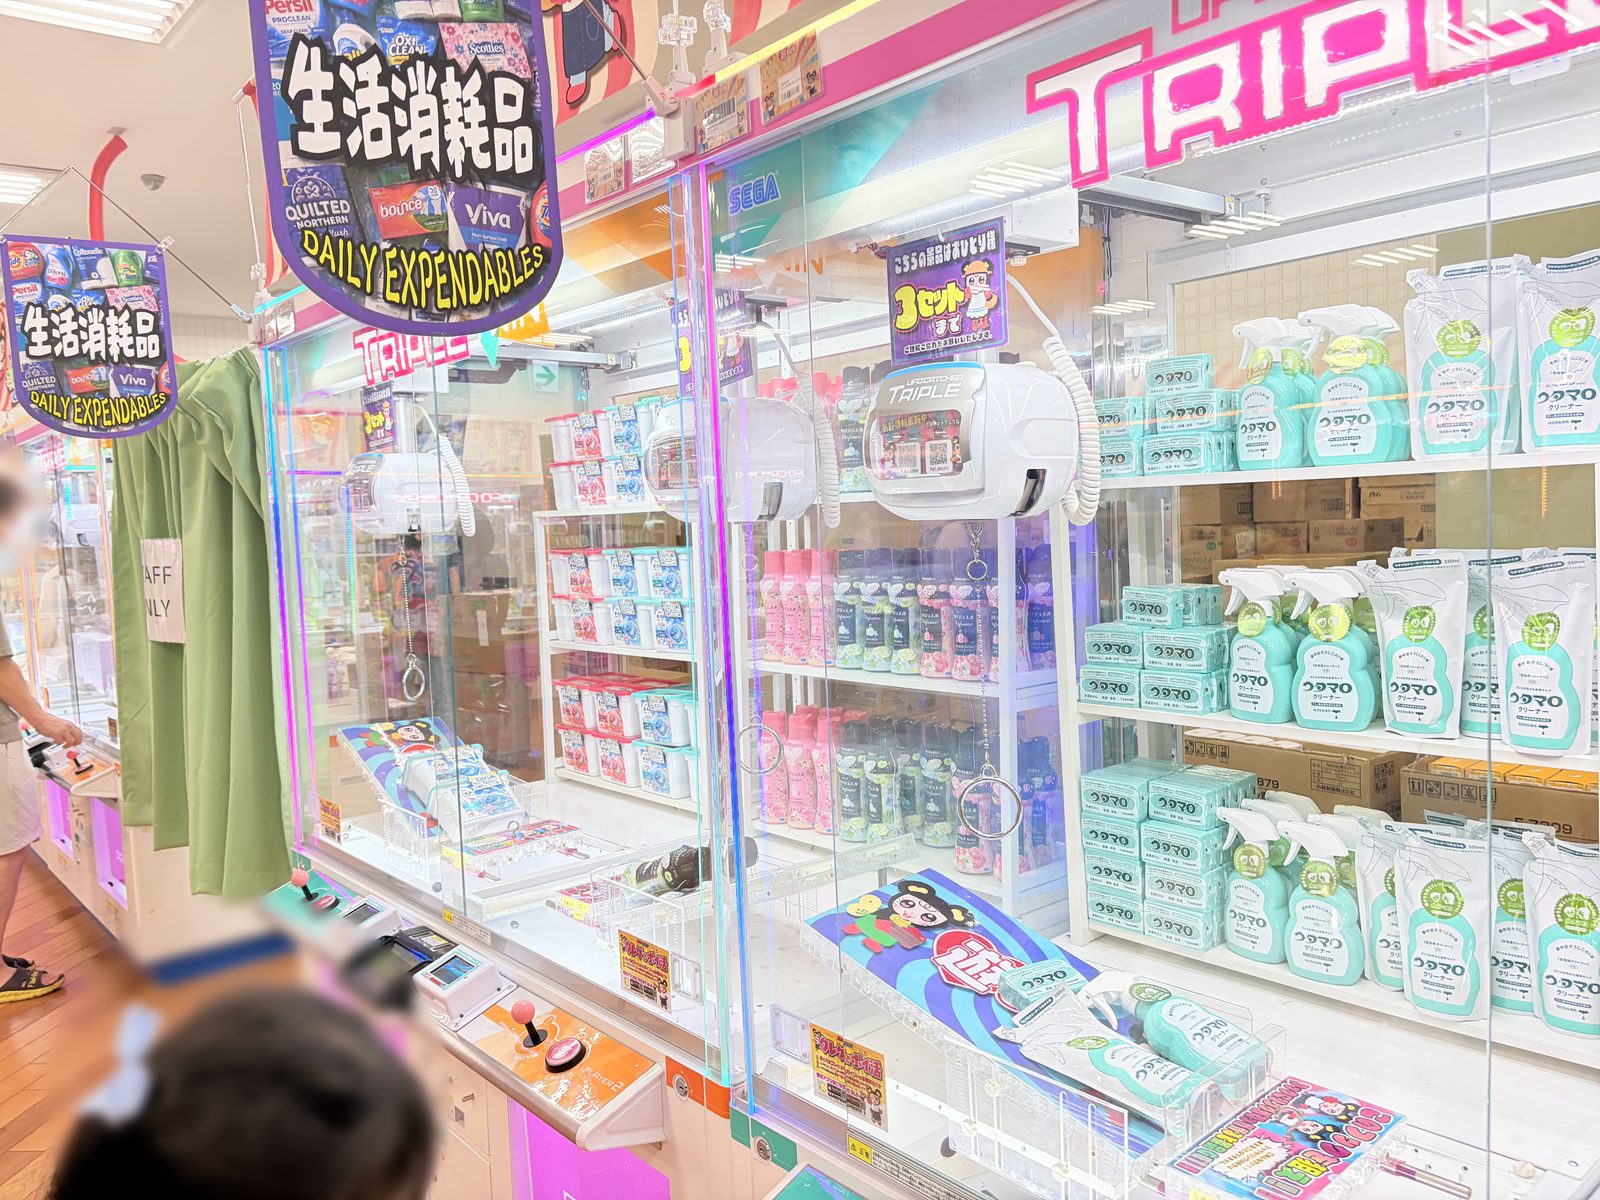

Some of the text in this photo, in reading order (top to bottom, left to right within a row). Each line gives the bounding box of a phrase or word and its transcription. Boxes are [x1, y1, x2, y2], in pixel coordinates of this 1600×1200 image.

[395, 34, 419, 46] OXI
[469, 42, 505, 54] Scotties
[288, 40, 534, 178] 生活消耗品
[728, 172, 781, 216] SEGA
[285, 200, 350, 221] QUILTED
[379, 197, 423, 219] bounce
[465, 203, 511, 229] Viva
[296, 215, 349, 230] NORTHERN
[894, 229, 996, 275] こちらの景品はおひとり様
[303, 230, 543, 309] DAILY EXPENDABLES
[13, 285, 38, 294] Persil
[893, 281, 966, 331] 3セット
[935, 314, 962, 335] まで
[24, 306, 160, 362] 生活消耗品
[22, 376, 56, 389] QUILTED
[119, 373, 147, 386] Viva
[1154, 370, 1193, 384] ウタマロ
[888, 383, 962, 405] TRIPLE
[1537, 387, 1597, 404] ウタマロ
[30, 391, 166, 427] DAILY EXPENDABLES
[1165, 405, 1207, 421] ウタマロ
[1427, 399, 1485, 413] ウタマロ
[1548, 402, 1583, 411] クリーナー
[1240, 421, 1277, 435] ウタマロ
[1319, 413, 1371, 428] ウタマロ
[1329, 427, 1360, 435] クリーナー
[1151, 448, 1193, 462] ウタマロ
[144, 565, 172, 584] AFF
[145, 598, 171, 618] NLY
[1129, 602, 1163, 615] ウタマロ
[1092, 642, 1133, 655] ウタマロ
[1153, 645, 1195, 659] ウタマロ
[1089, 680, 1129, 694] ウタマロ
[1233, 672, 1268, 687] ウタマロ
[1302, 681, 1353, 694] ウタマロ
[1150, 686, 1192, 701] ウタマロ
[1390, 681, 1438, 695] ウタマロ
[1312, 693, 1341, 701] クリーナー
[1397, 694, 1425, 702] クリーナー
[1509, 692, 1563, 707] ウタマロ
[1517, 706, 1550, 714] クリーナー
[1090, 791, 1128, 808] ウタマロ
[1158, 796, 1196, 814] ウタマロ
[1089, 829, 1129, 846] ウタマロ
[1150, 839, 1191, 858] ウタマロ
[1093, 865, 1133, 882] ウタマロ
[1154, 878, 1196, 897] ウタマロ
[1095, 902, 1134, 920] ウタマロ
[1229, 909, 1267, 928] ウタマロ
[1152, 917, 1193, 937] ウタマロ
[1236, 922, 1258, 932] クリーナー
[1294, 931, 1343, 949] ウタマロ
[1304, 944, 1332, 954] クリーナー
[1413, 956, 1465, 977] ウタマロ
[1021, 969, 1068, 990] ウタマロ
[1423, 971, 1454, 981] クリーナー
[1556, 989, 1591, 1000] クリーナー
[1191, 1018, 1229, 1042] ウタマロ
[582, 1066, 625, 1092] PLAYER 2
